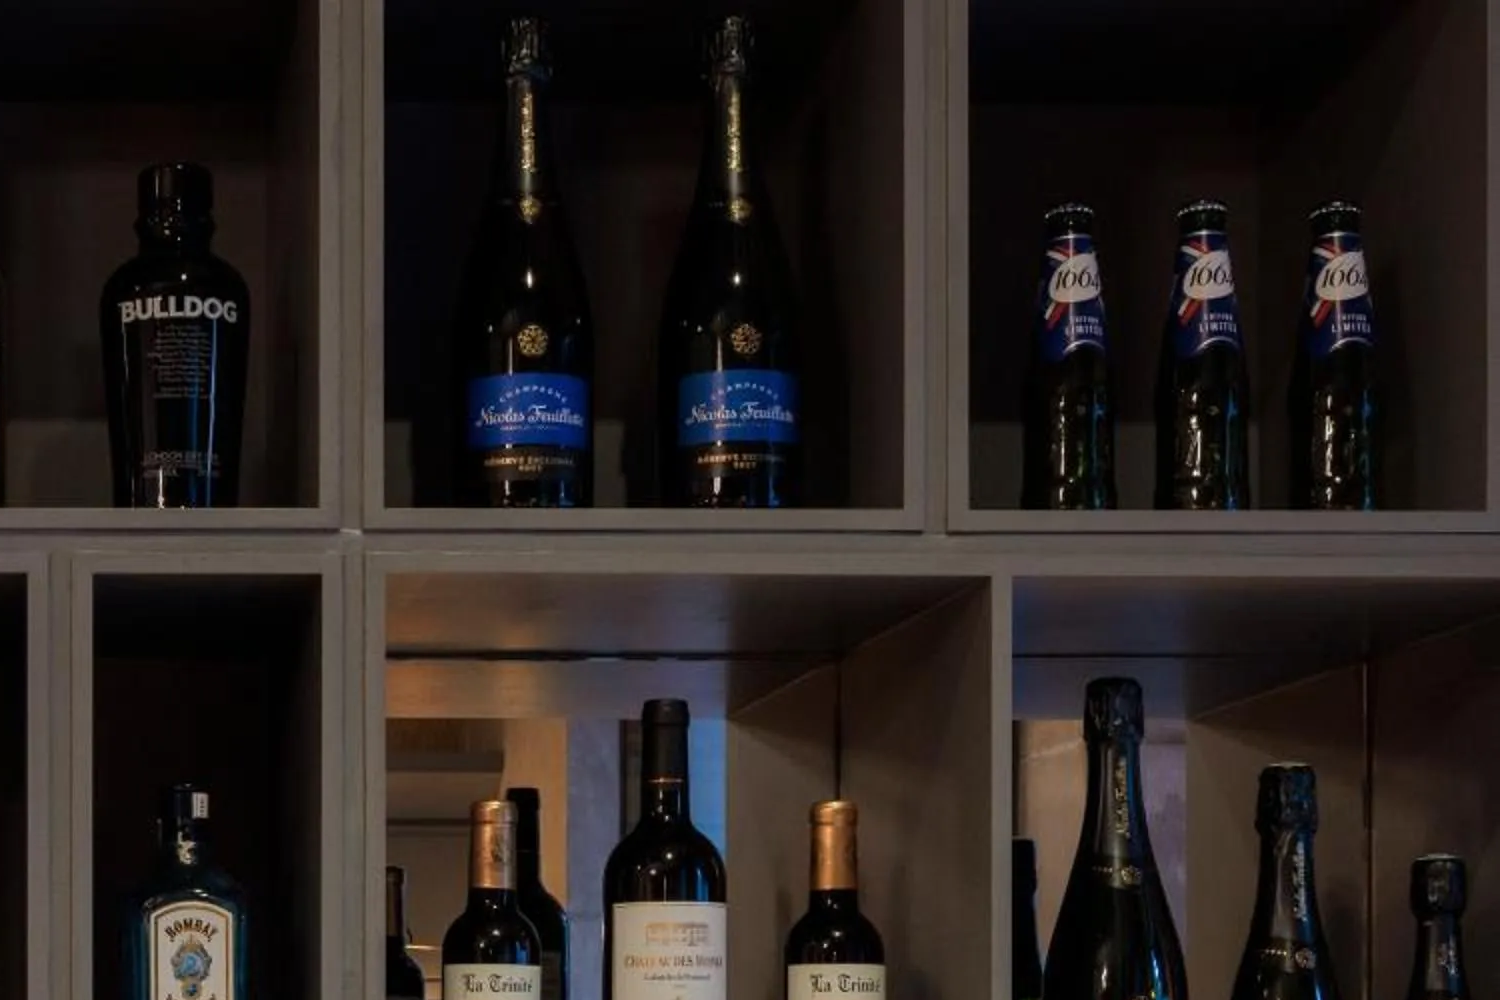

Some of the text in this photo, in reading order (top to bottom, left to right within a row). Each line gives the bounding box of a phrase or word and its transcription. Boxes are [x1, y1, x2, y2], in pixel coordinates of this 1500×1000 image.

[1055, 266, 1100, 291] 1664
[1321, 264, 1367, 289] 1664
[118, 295, 238, 324] BULLDOG
[476, 404, 525, 427] Nicolas
[684, 402, 737, 426] Nicolas
[164, 918, 218, 942] BOMBAY
[462, 973, 483, 993] La
[809, 973, 832, 993] La
